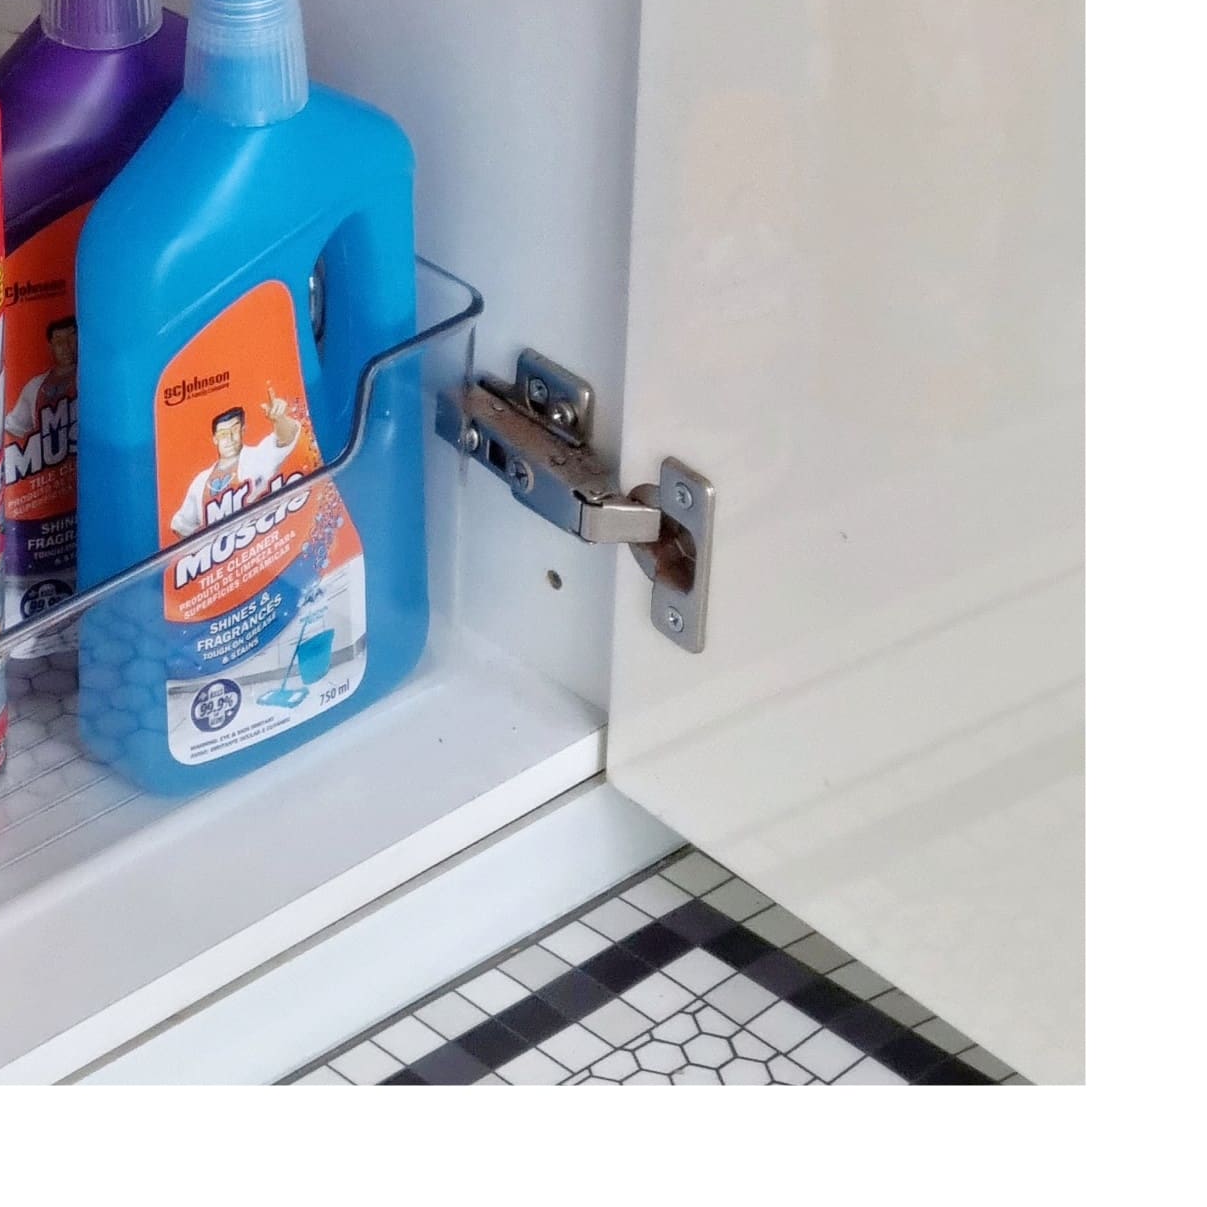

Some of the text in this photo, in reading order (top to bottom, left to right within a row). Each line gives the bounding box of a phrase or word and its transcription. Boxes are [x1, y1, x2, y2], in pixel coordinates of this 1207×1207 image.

[206, 483, 249, 525] Mr
[199, 531, 280, 590] TILE CLEANER
[197, 594, 282, 652] FRAGRANCES
[210, 591, 271, 634] SHINES &
